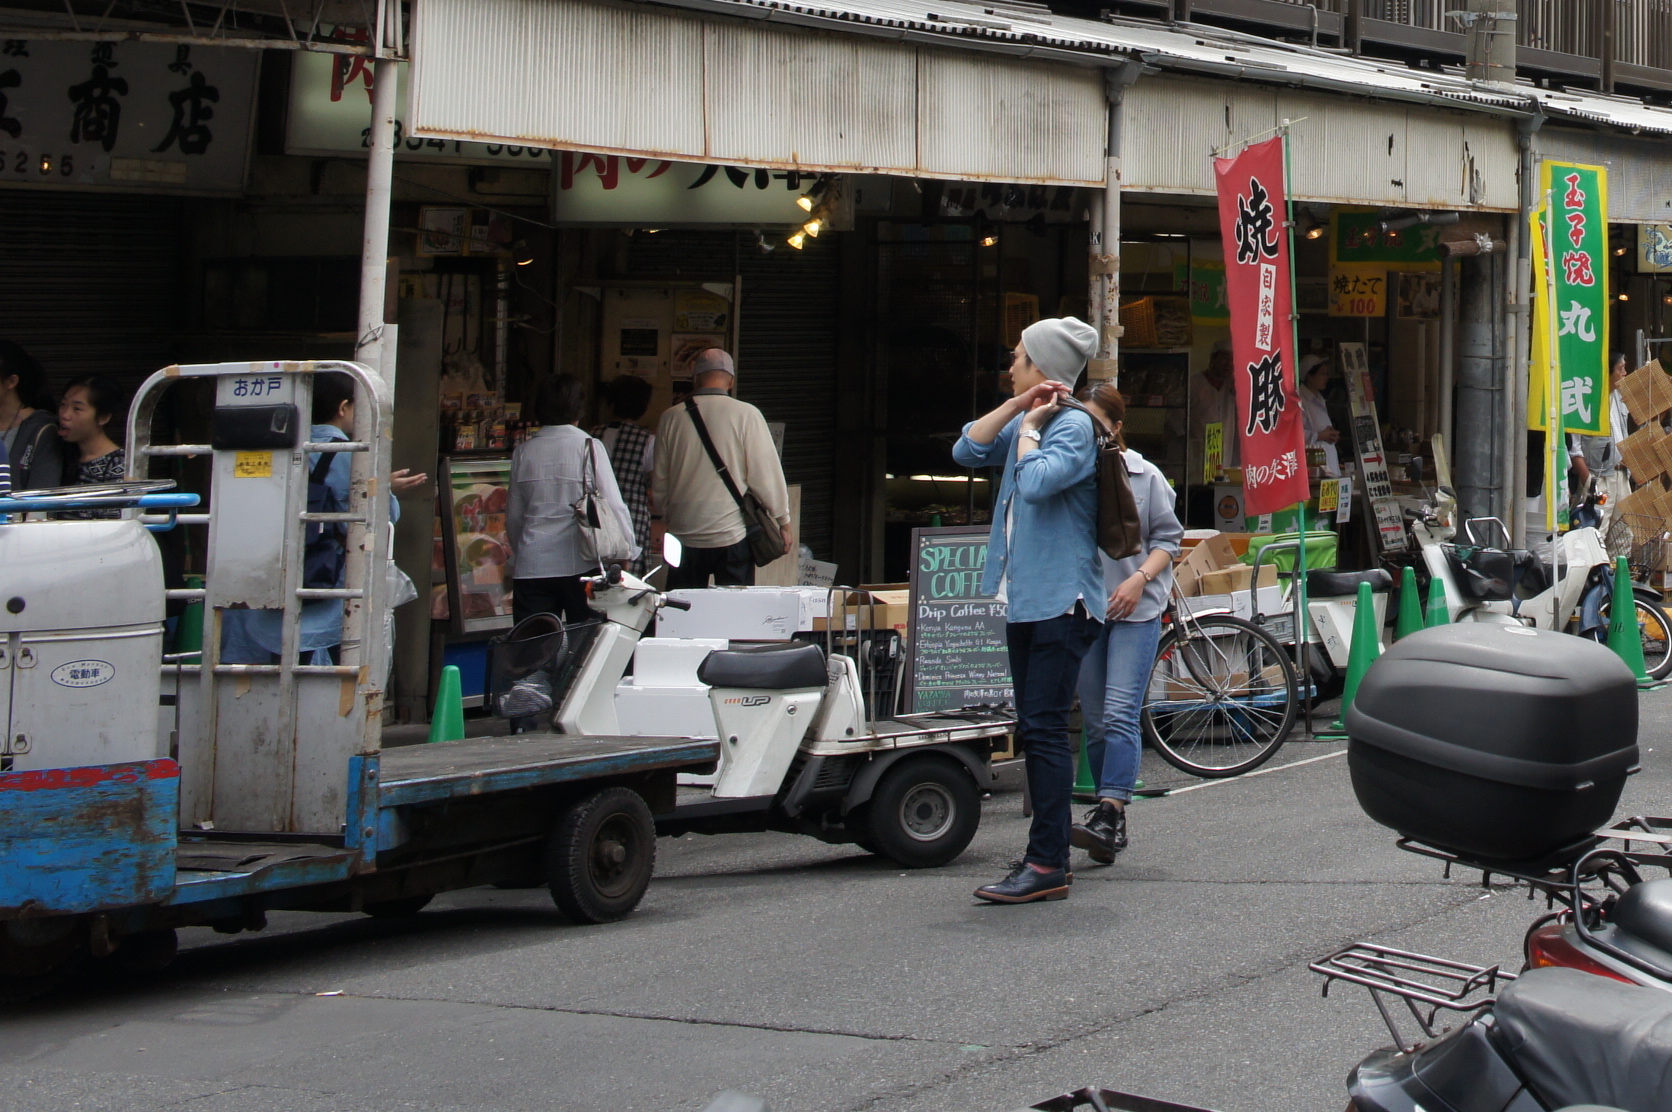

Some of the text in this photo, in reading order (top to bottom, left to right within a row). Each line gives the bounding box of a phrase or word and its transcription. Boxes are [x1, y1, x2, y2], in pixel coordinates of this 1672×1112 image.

[1561, 172, 1596, 287] 玉子焼
[1332, 274, 1383, 296] 焼たて
[1258, 266, 1275, 347] 自家製
[233, 376, 282, 397] おか戸
[1245, 449, 1299, 490] 肉の矢澤
[930, 570, 986, 599] COFF
[919, 605, 946, 621] Drip
[950, 604, 986, 618] Coffee
[974, 621, 985, 629] AA
[69, 668, 101, 680] 電動車
